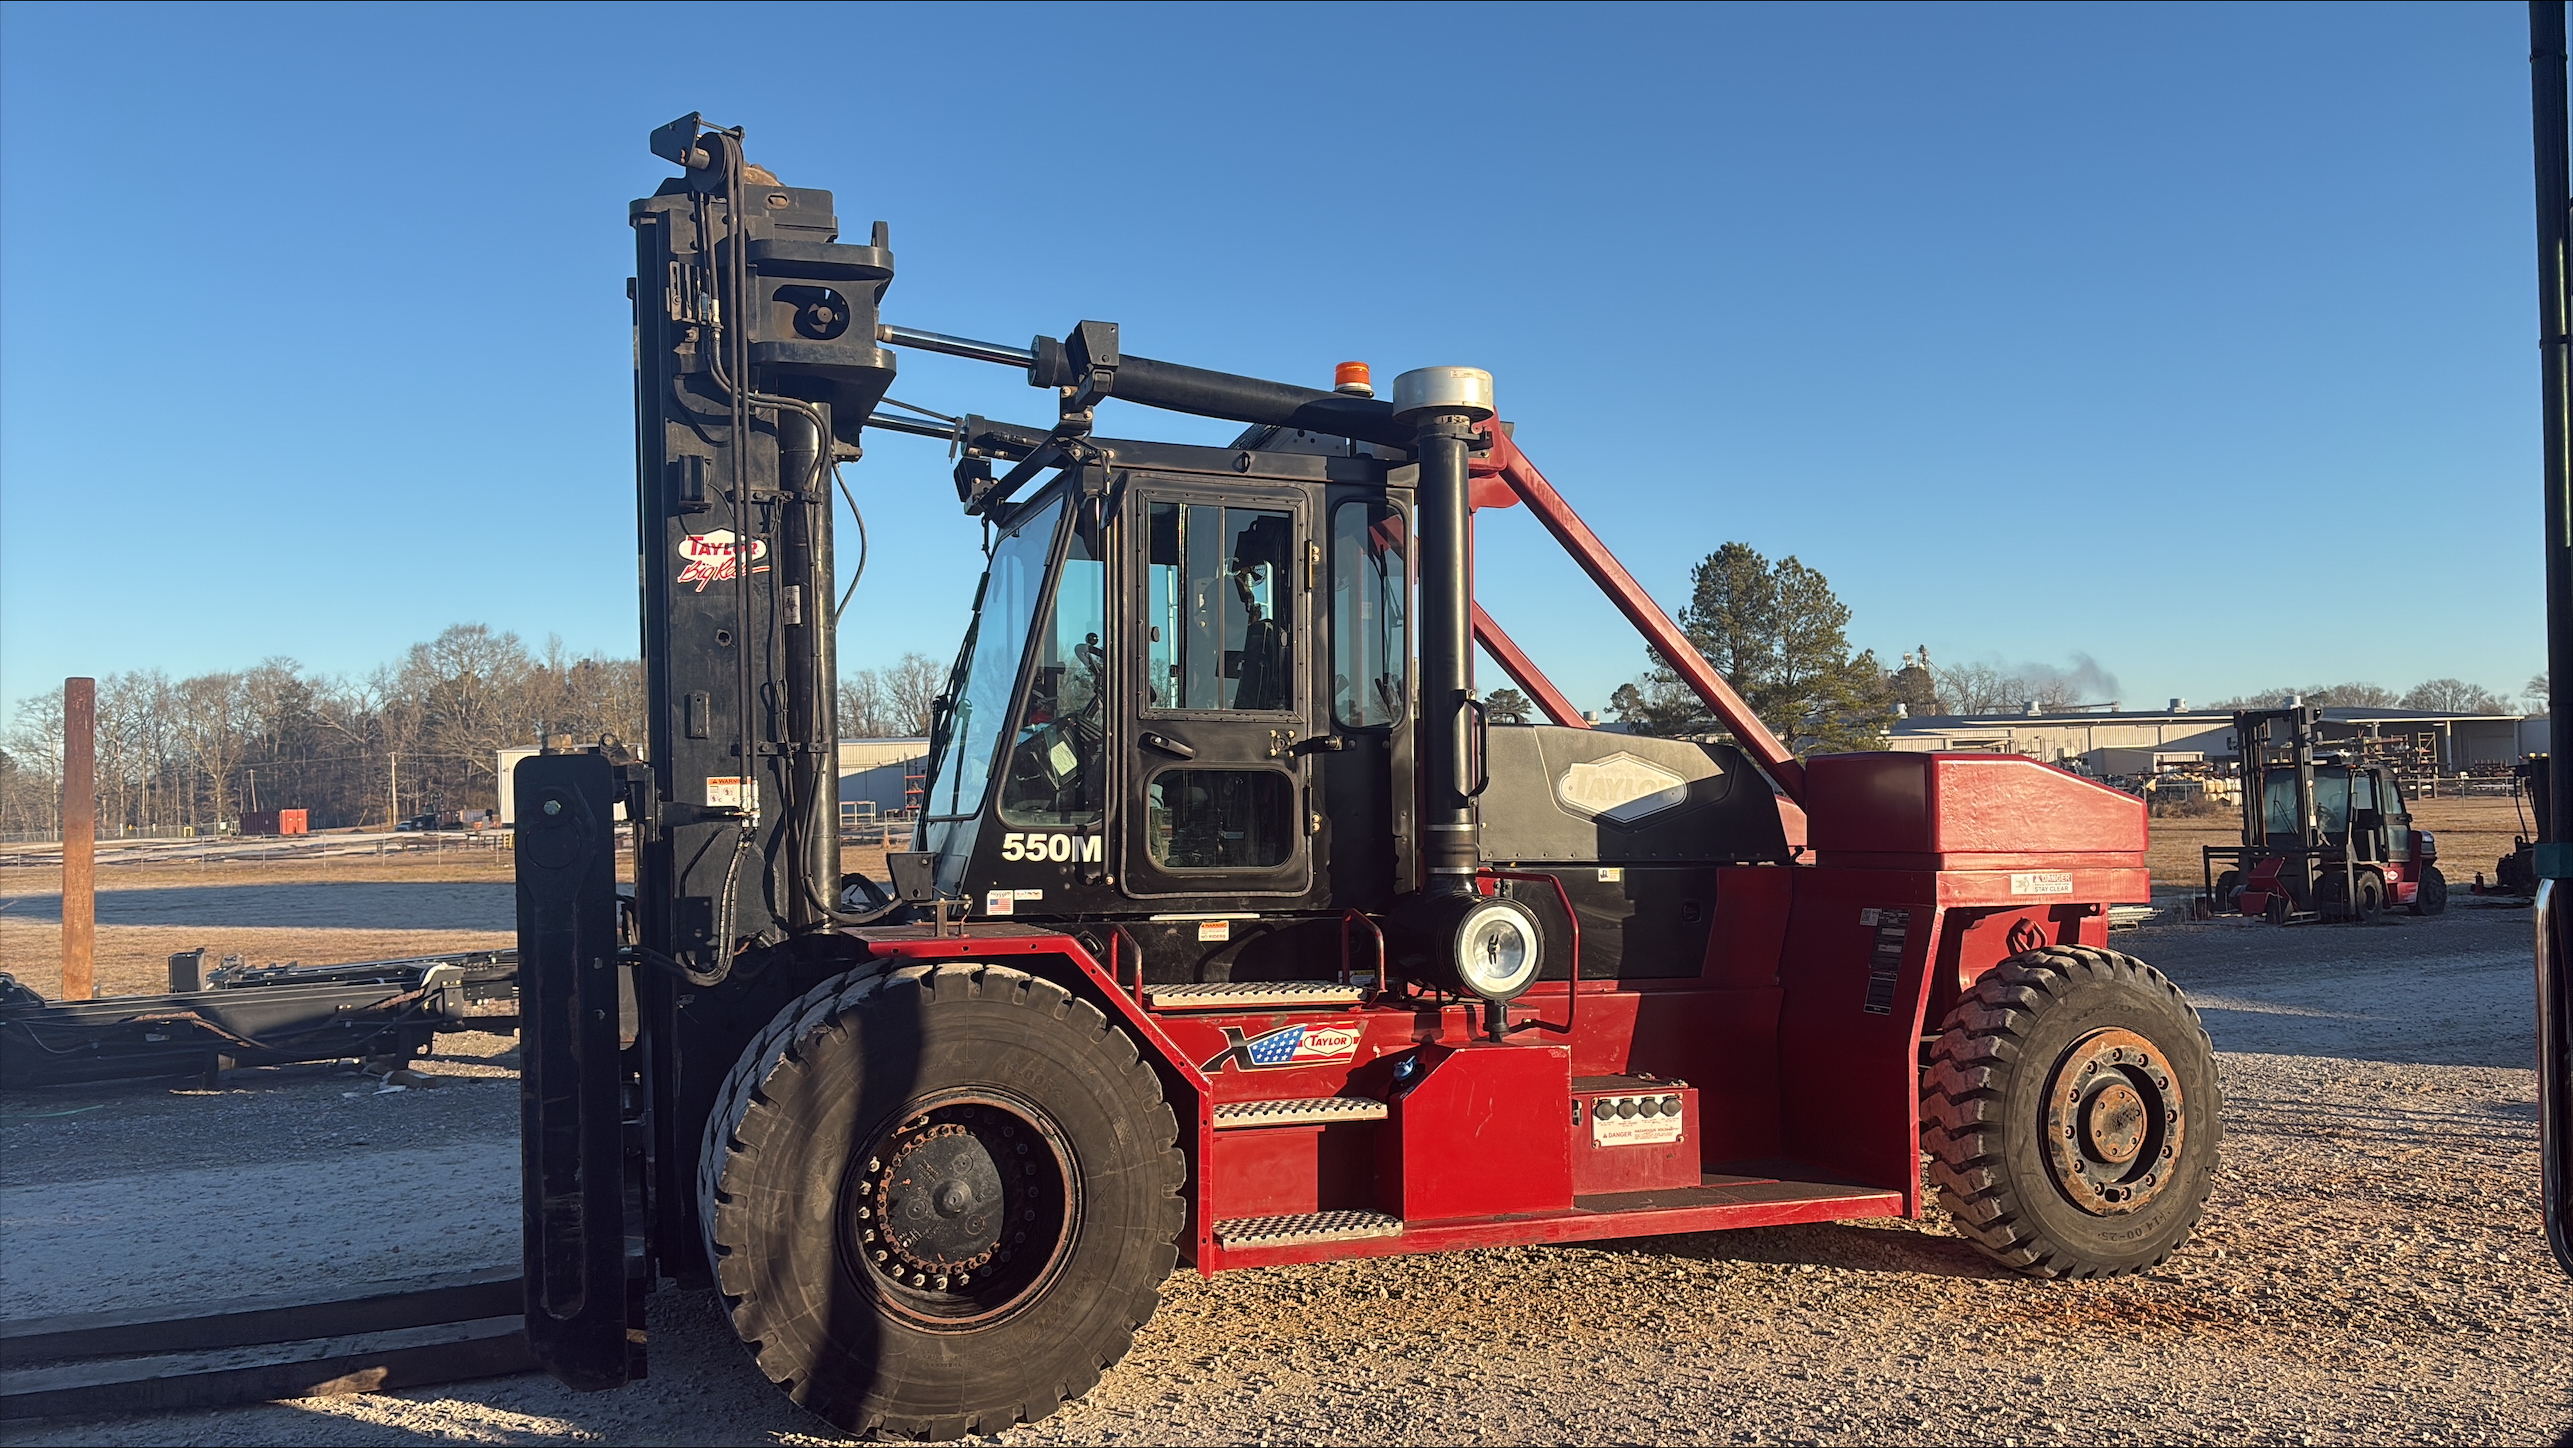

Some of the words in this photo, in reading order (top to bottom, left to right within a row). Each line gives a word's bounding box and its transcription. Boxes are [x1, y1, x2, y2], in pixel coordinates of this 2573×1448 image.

[1572, 767, 1676, 801] TAYLOR
[1002, 833, 1102, 862] 550M
[2043, 874, 2070, 883] DANGER
[1310, 1034, 1347, 1047] TAYLOR
